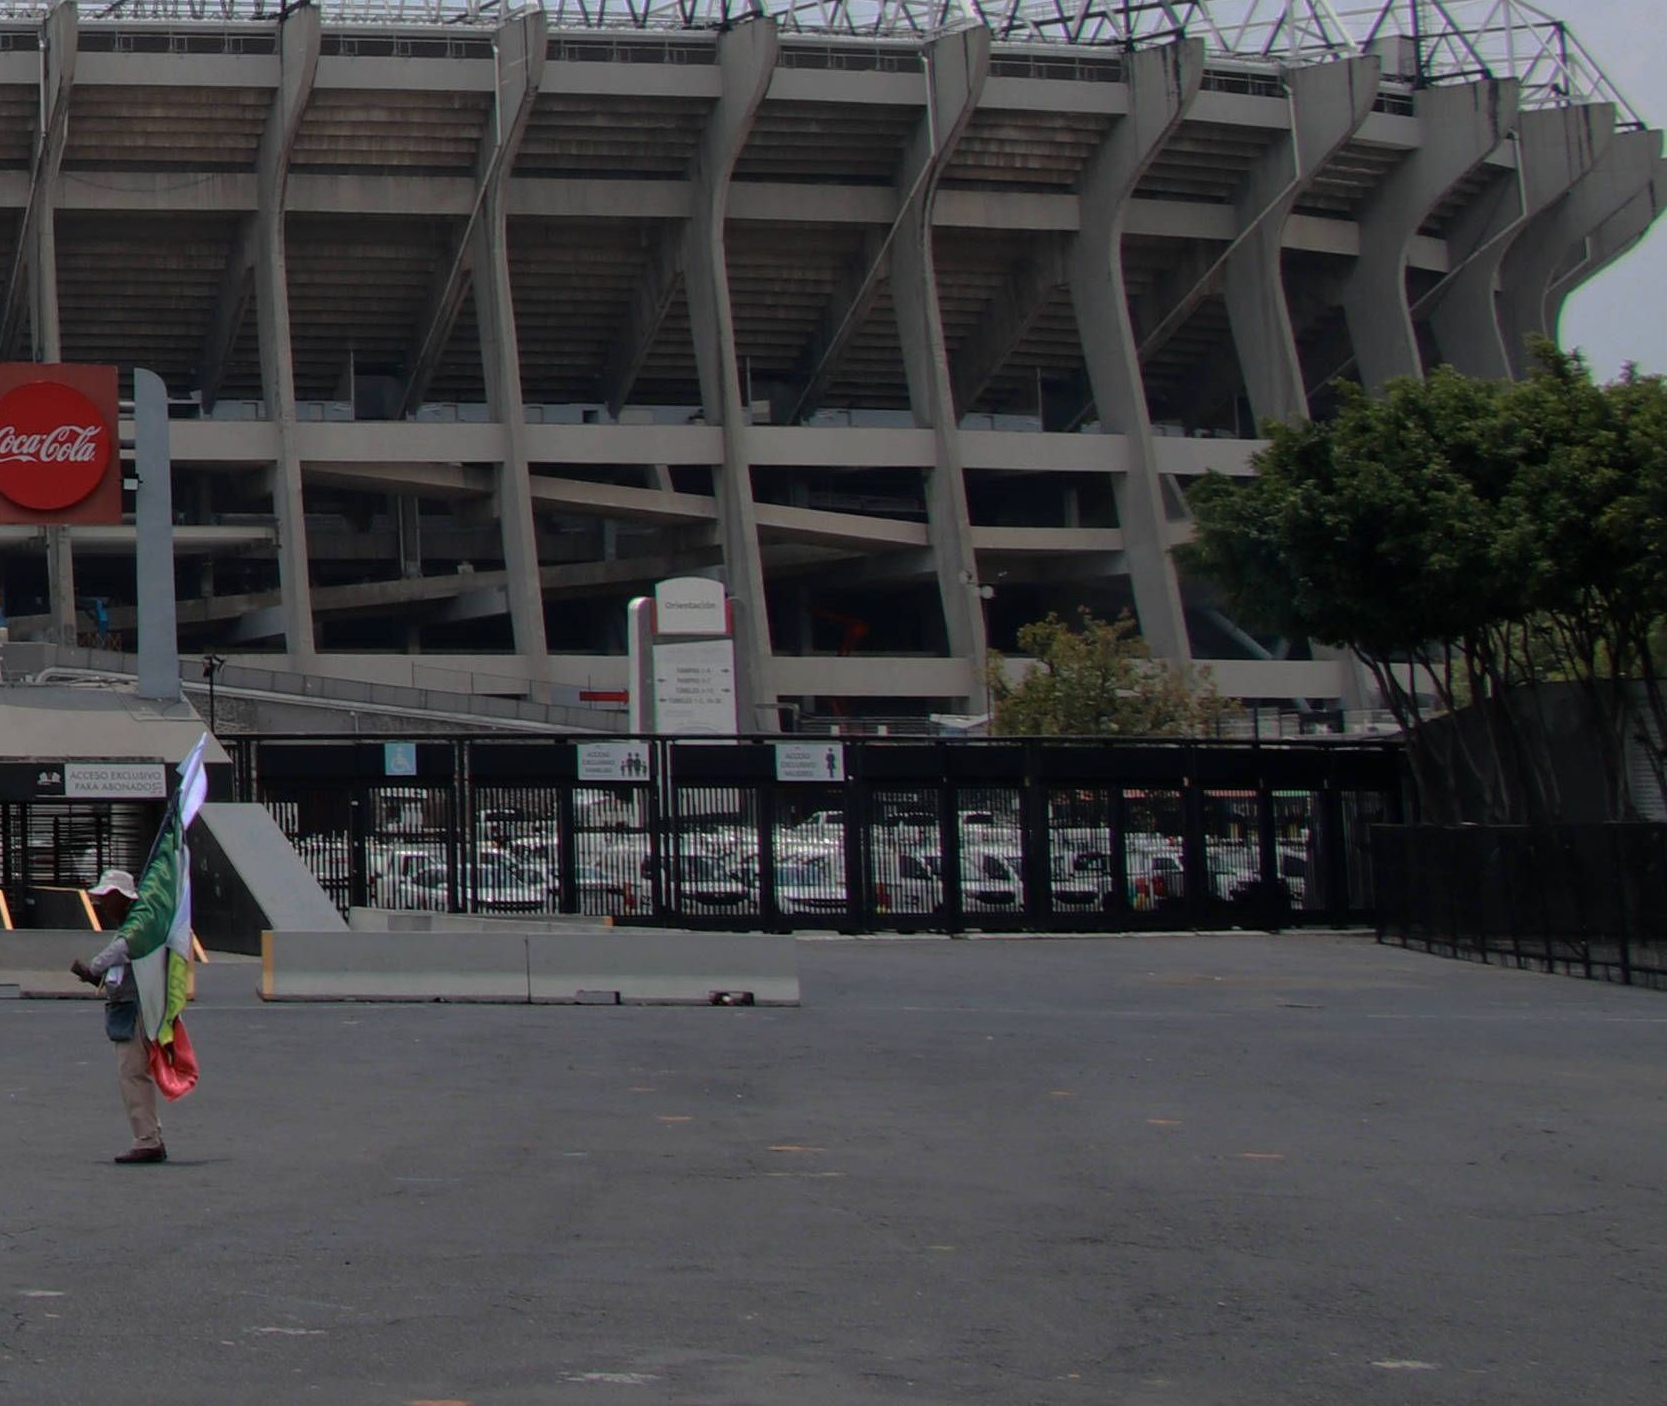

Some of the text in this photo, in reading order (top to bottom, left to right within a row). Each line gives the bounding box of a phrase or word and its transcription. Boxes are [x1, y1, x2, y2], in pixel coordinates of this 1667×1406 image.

[69, 771, 161, 781] ACCESO EXCLUSIVO
[74, 782, 100, 791] PARA
[101, 782, 157, 791] ABONADOS
